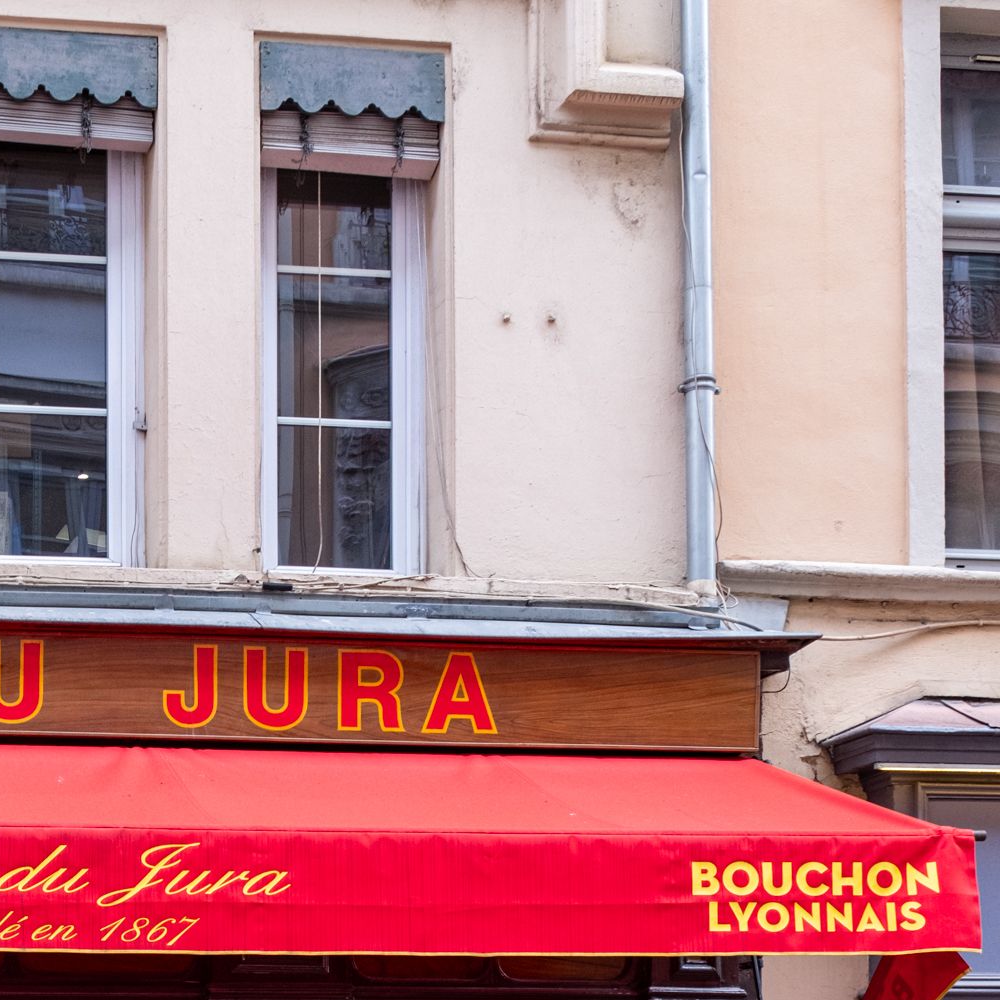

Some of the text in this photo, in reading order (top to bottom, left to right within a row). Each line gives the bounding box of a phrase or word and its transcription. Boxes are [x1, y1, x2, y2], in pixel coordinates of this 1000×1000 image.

[162, 643, 499, 735] JURA
[96, 842, 292, 907] Jura
[691, 861, 941, 897] BOUCHON
[30, 925, 78, 942] en
[99, 916, 201, 946] 1867
[708, 901, 927, 933] LYONNAIS
